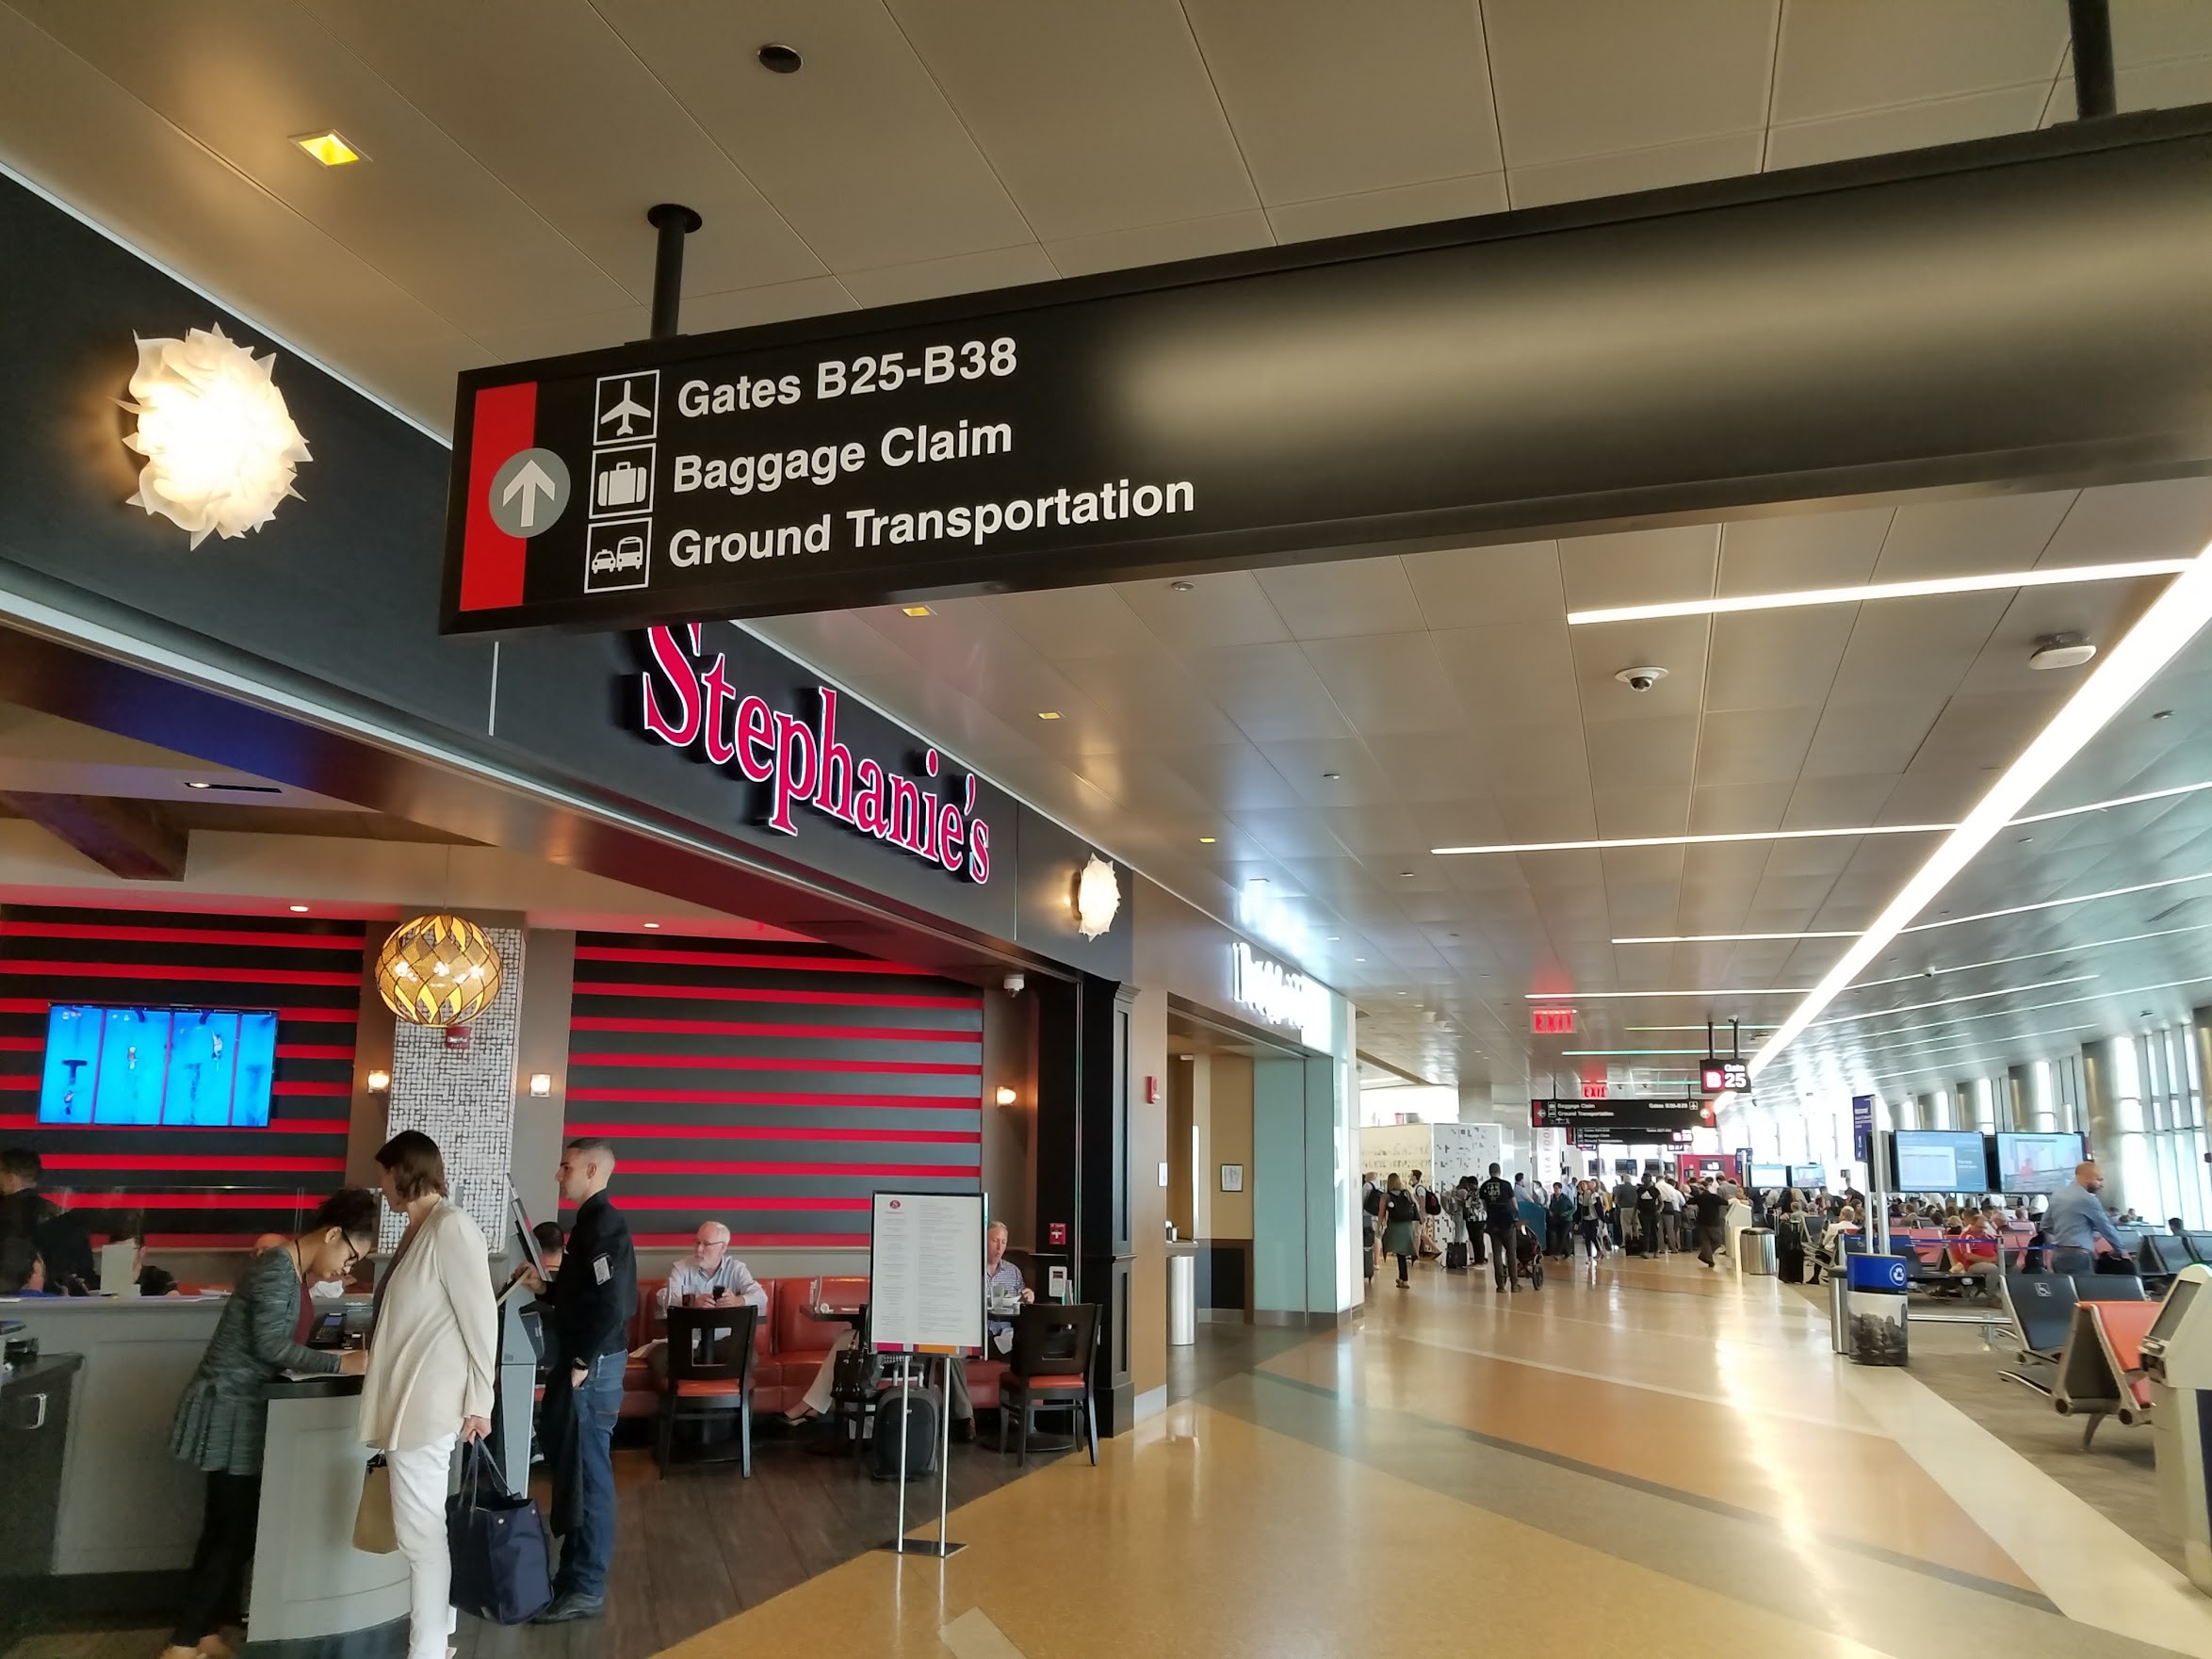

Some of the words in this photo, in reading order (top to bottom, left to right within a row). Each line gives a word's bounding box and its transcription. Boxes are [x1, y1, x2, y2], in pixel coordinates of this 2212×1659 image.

[677, 375, 801, 417] Gates
[817, 336, 1017, 399] B25-B38
[674, 441, 865, 495] Baggage
[880, 421, 1013, 467] Claim
[668, 514, 831, 569] Ground
[847, 479, 1195, 546] Transportation
[642, 623, 990, 884] Stephanie's
[1535, 1013, 1573, 1033] EXIT
[1724, 1072, 1747, 1088] 25
